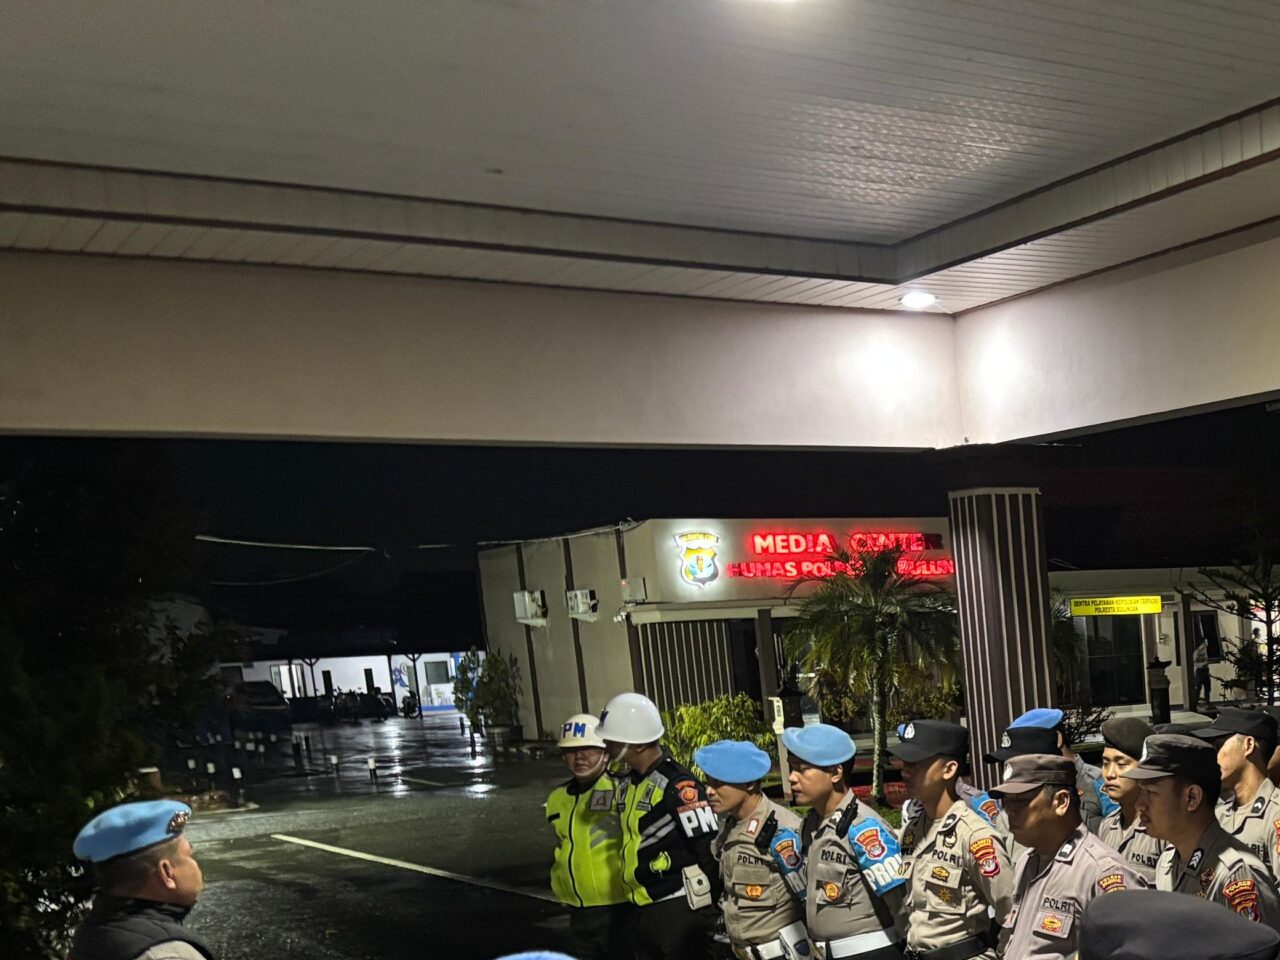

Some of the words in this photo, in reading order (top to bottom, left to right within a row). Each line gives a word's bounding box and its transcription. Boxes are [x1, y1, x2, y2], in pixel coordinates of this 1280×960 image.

[753, 534, 833, 554] MEDIA
[726, 561, 798, 577] HUMAS
[562, 722, 587, 738] PM
[678, 806, 719, 838] PM
[821, 849, 848, 865] POLRI
[932, 849, 961, 867] POLRI
[1042, 896, 1075, 913] POLRI
